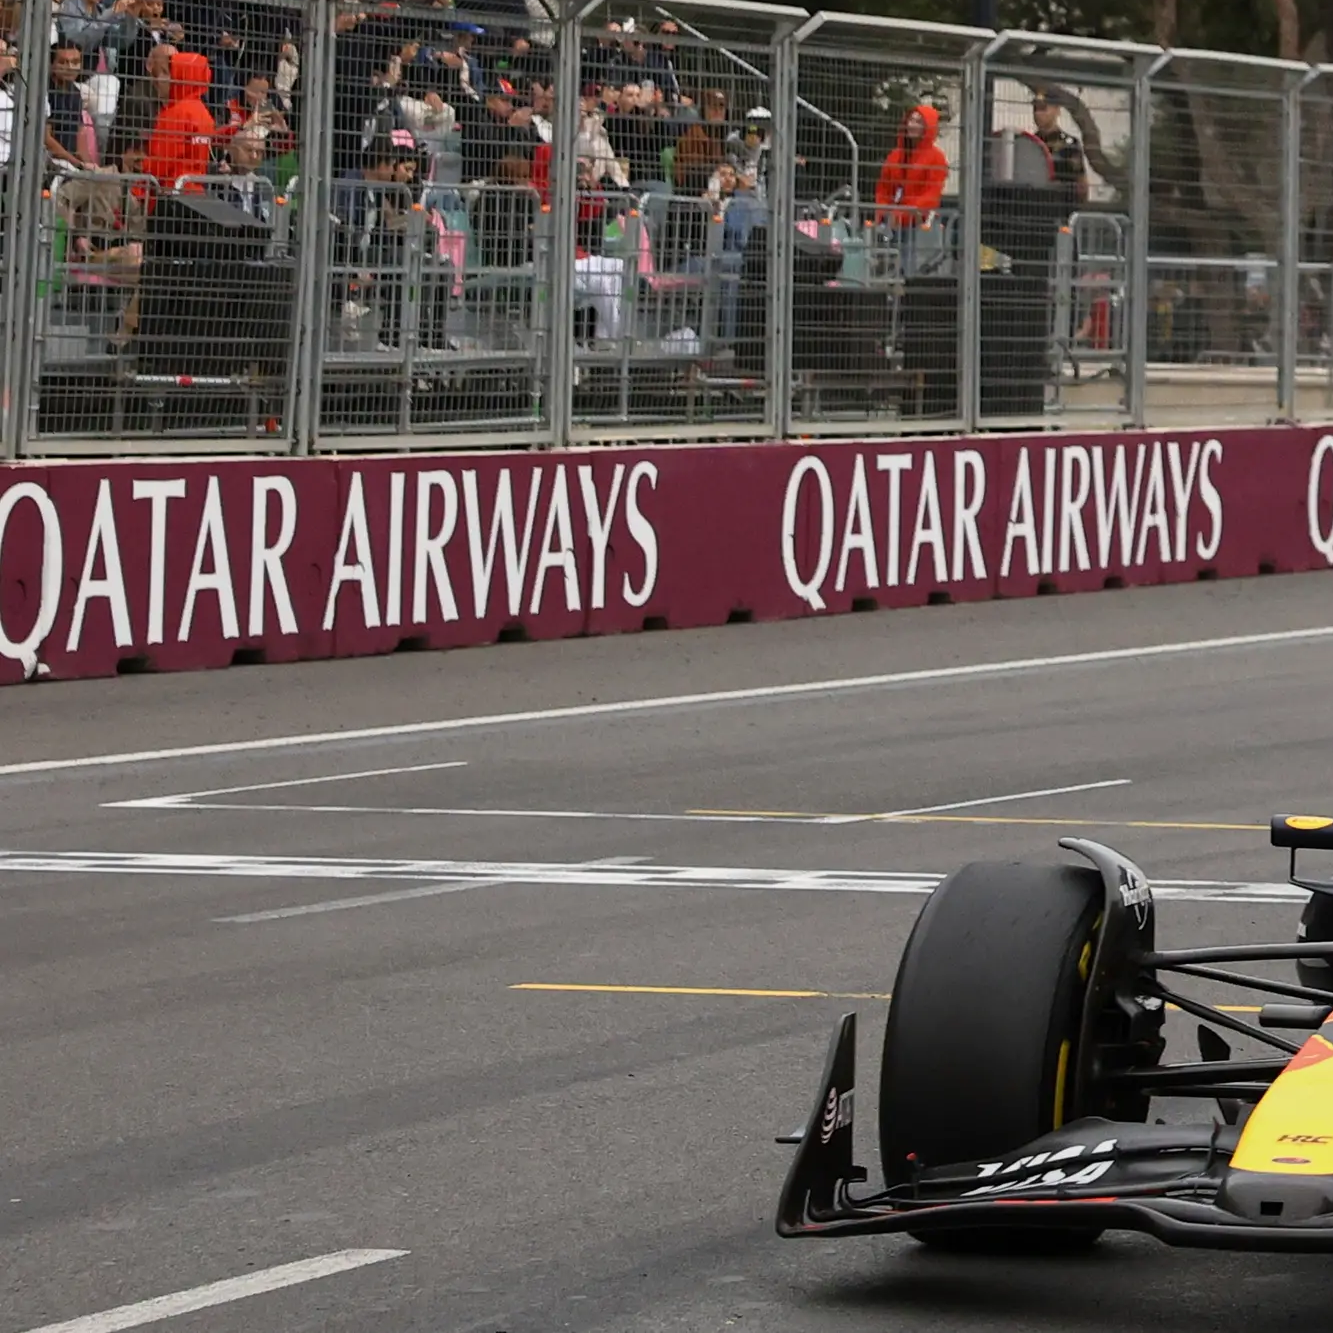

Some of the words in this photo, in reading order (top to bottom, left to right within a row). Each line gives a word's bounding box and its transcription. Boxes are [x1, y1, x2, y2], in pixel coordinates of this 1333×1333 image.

[0, 474, 300, 680] QATAR
[323, 460, 660, 632] AIRWAYS
[782, 449, 988, 611] QATAR
[1000, 438, 1224, 577] AIRWAYS
